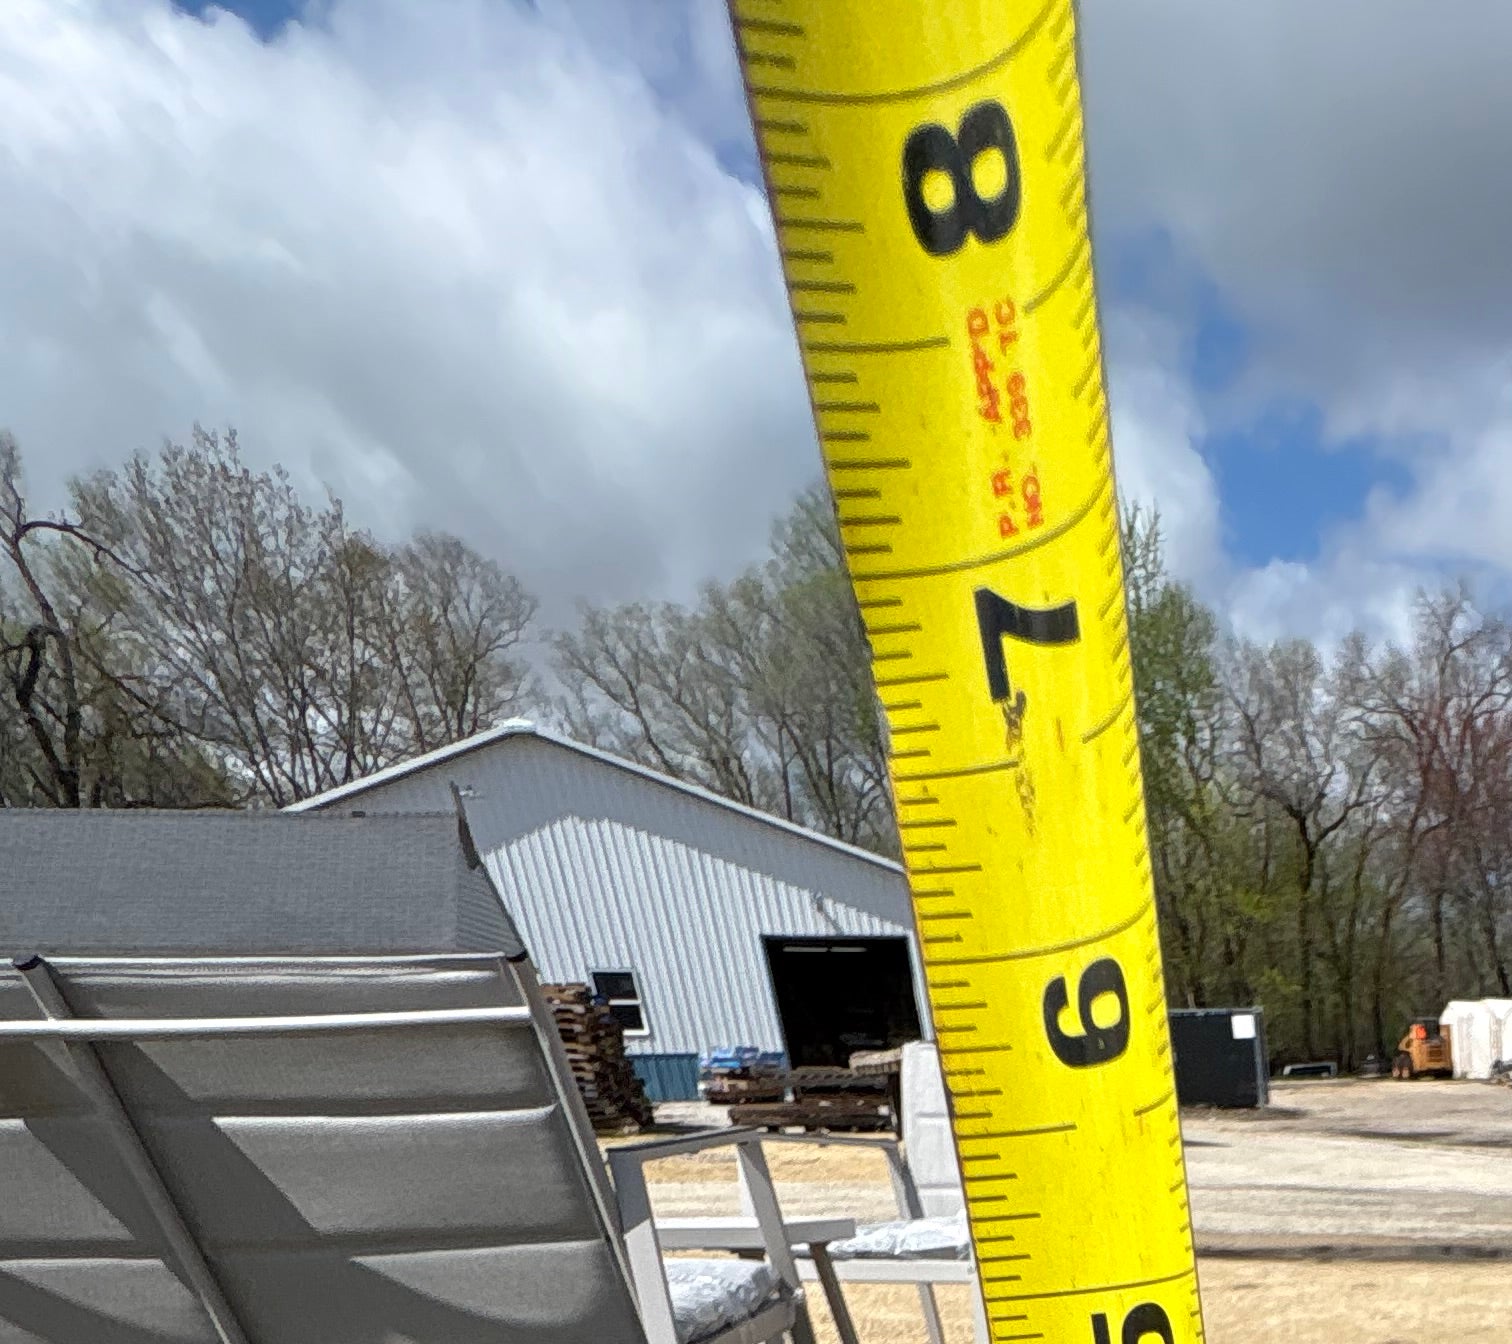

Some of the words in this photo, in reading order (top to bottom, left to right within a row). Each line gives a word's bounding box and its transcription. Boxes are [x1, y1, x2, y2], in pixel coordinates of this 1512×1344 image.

[900, 100, 1021, 257] 8
[974, 586, 1081, 703] 7
[1042, 957, 1131, 1068] 6
